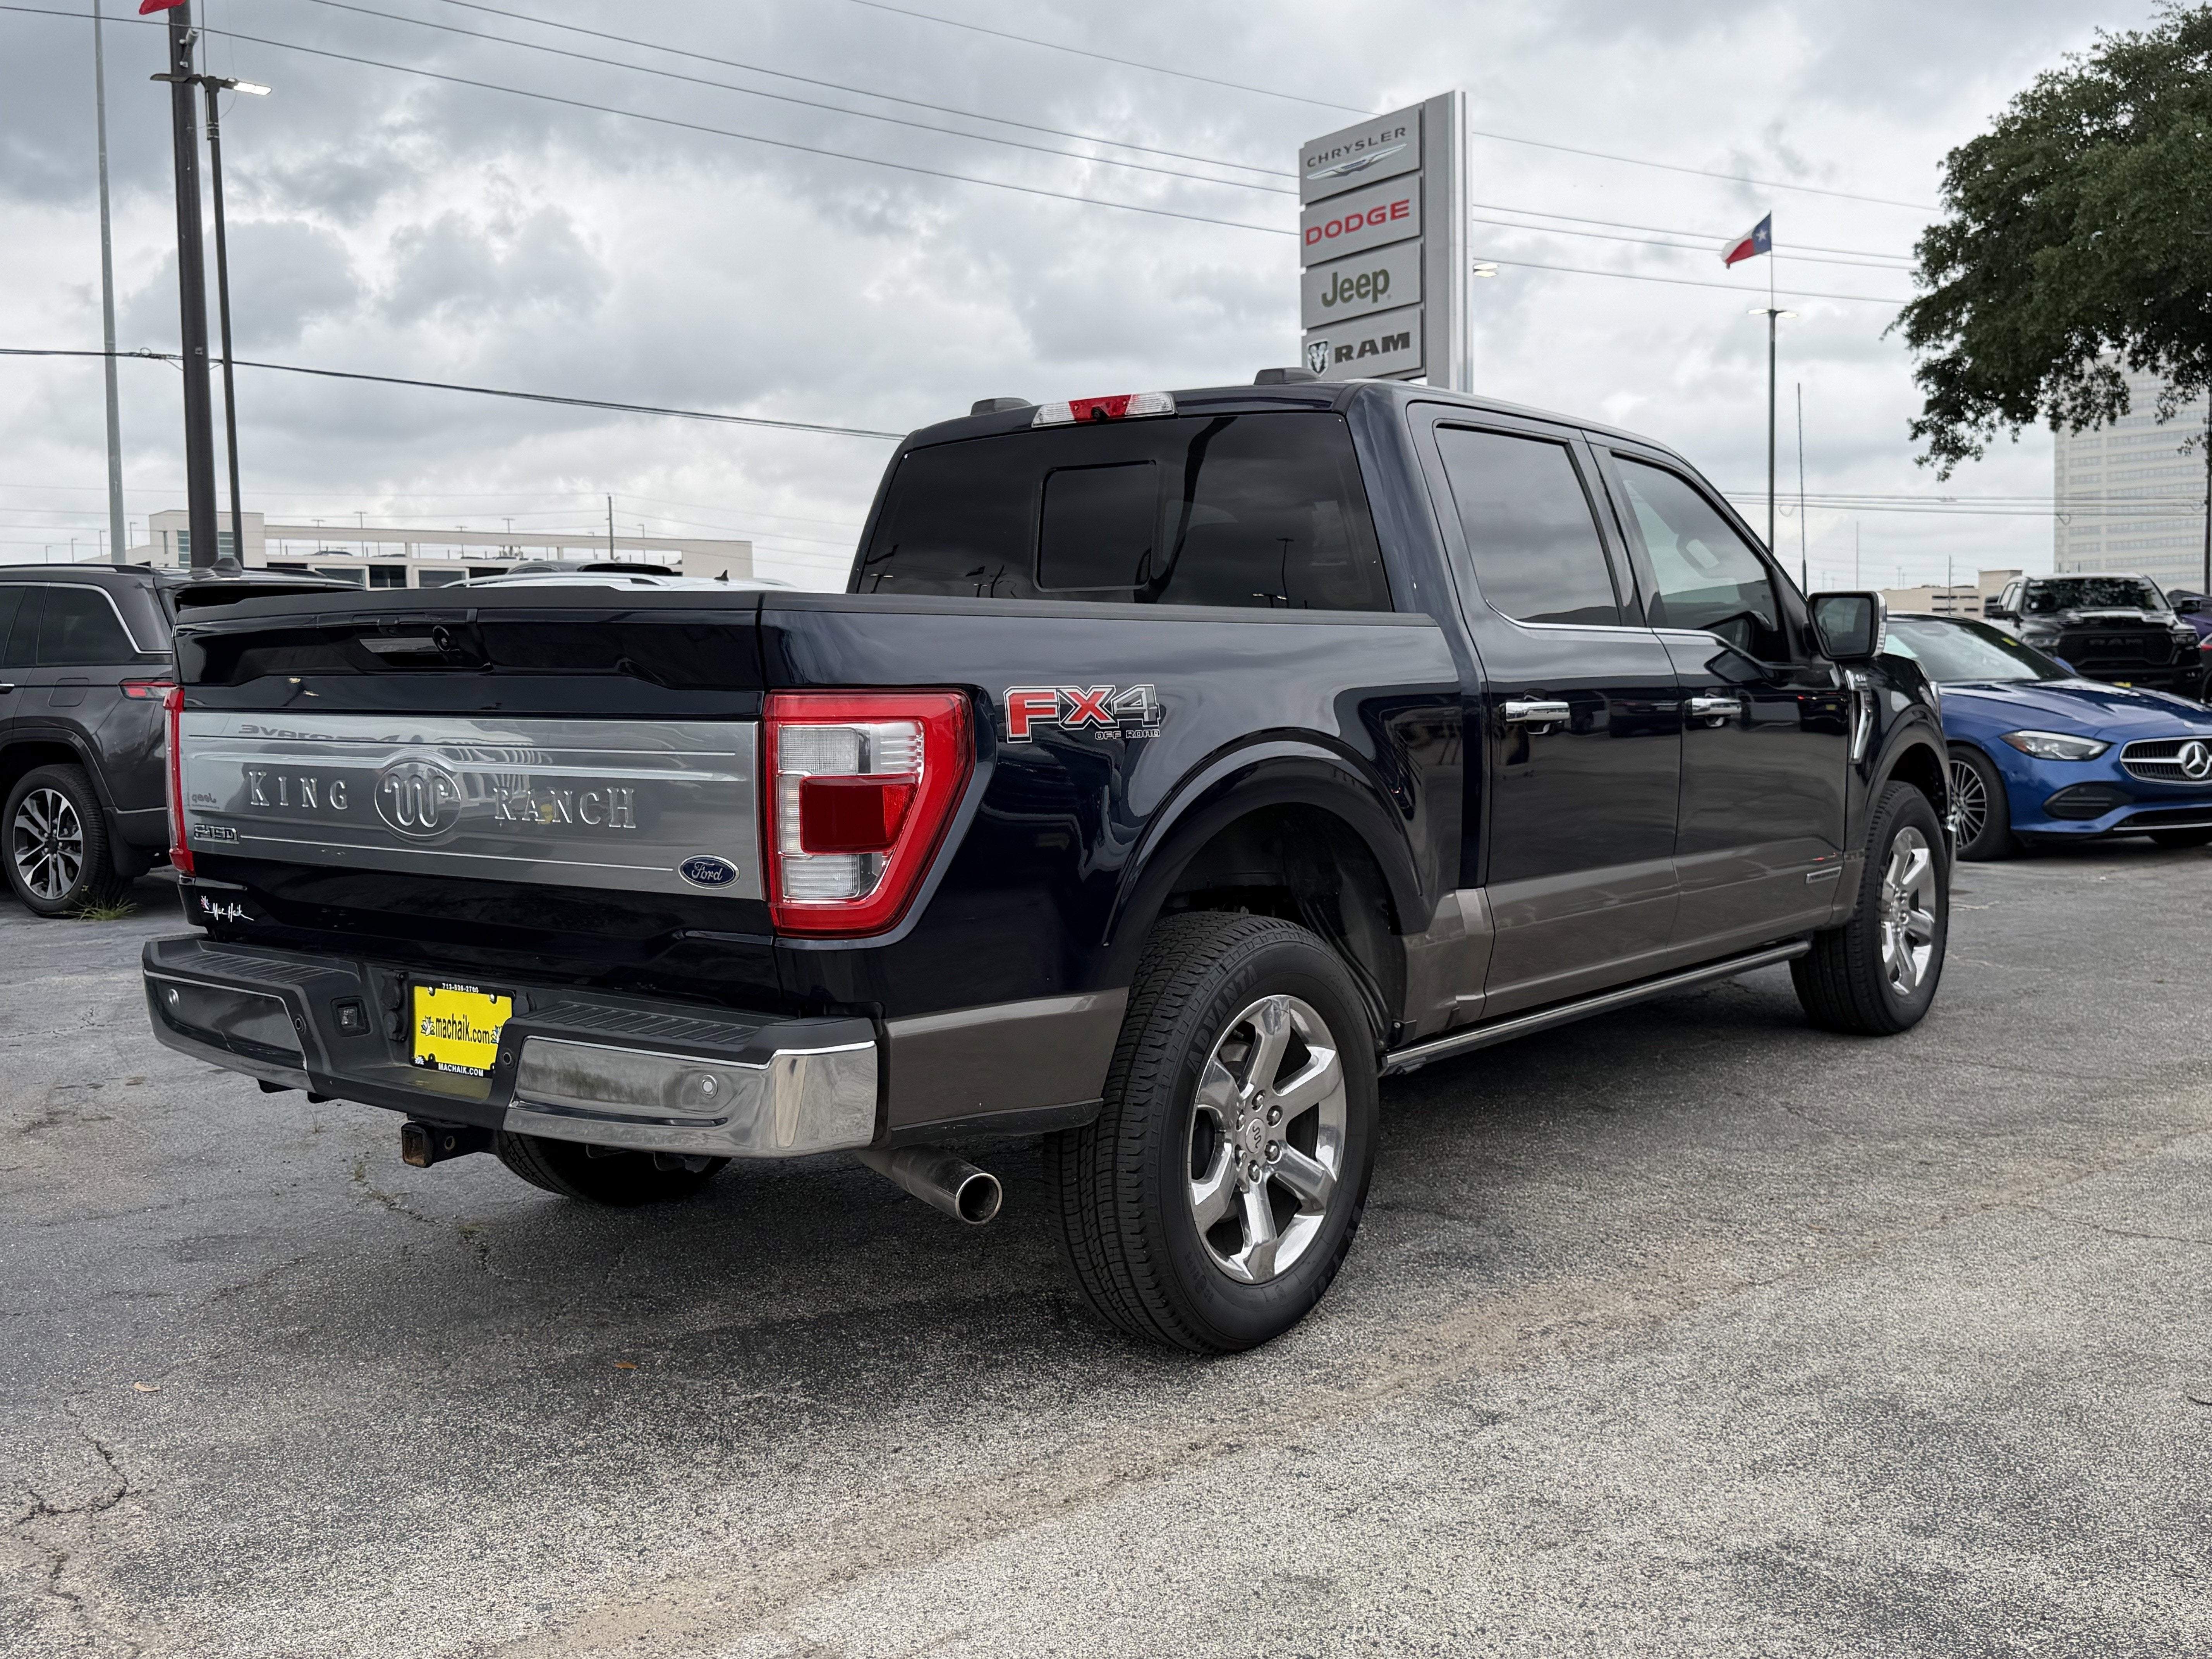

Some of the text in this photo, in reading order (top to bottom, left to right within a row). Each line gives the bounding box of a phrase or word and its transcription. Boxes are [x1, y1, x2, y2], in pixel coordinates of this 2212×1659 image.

[1307, 127, 1407, 167] CHRYSLER
[1305, 199, 1410, 246] DODGE
[1321, 268, 1390, 307] Jeep
[1335, 331, 1410, 363] RAM
[1003, 684, 1160, 743] FX4
[1095, 729, 1160, 740] OFF ROAD
[249, 771, 636, 828] KING RANCH
[691, 862, 723, 881] Ford
[436, 1013, 490, 1044] machaik.com
[1187, 965, 1258, 1074] ADVANTA
[438, 1063, 484, 1077] MACHAIK.COM
